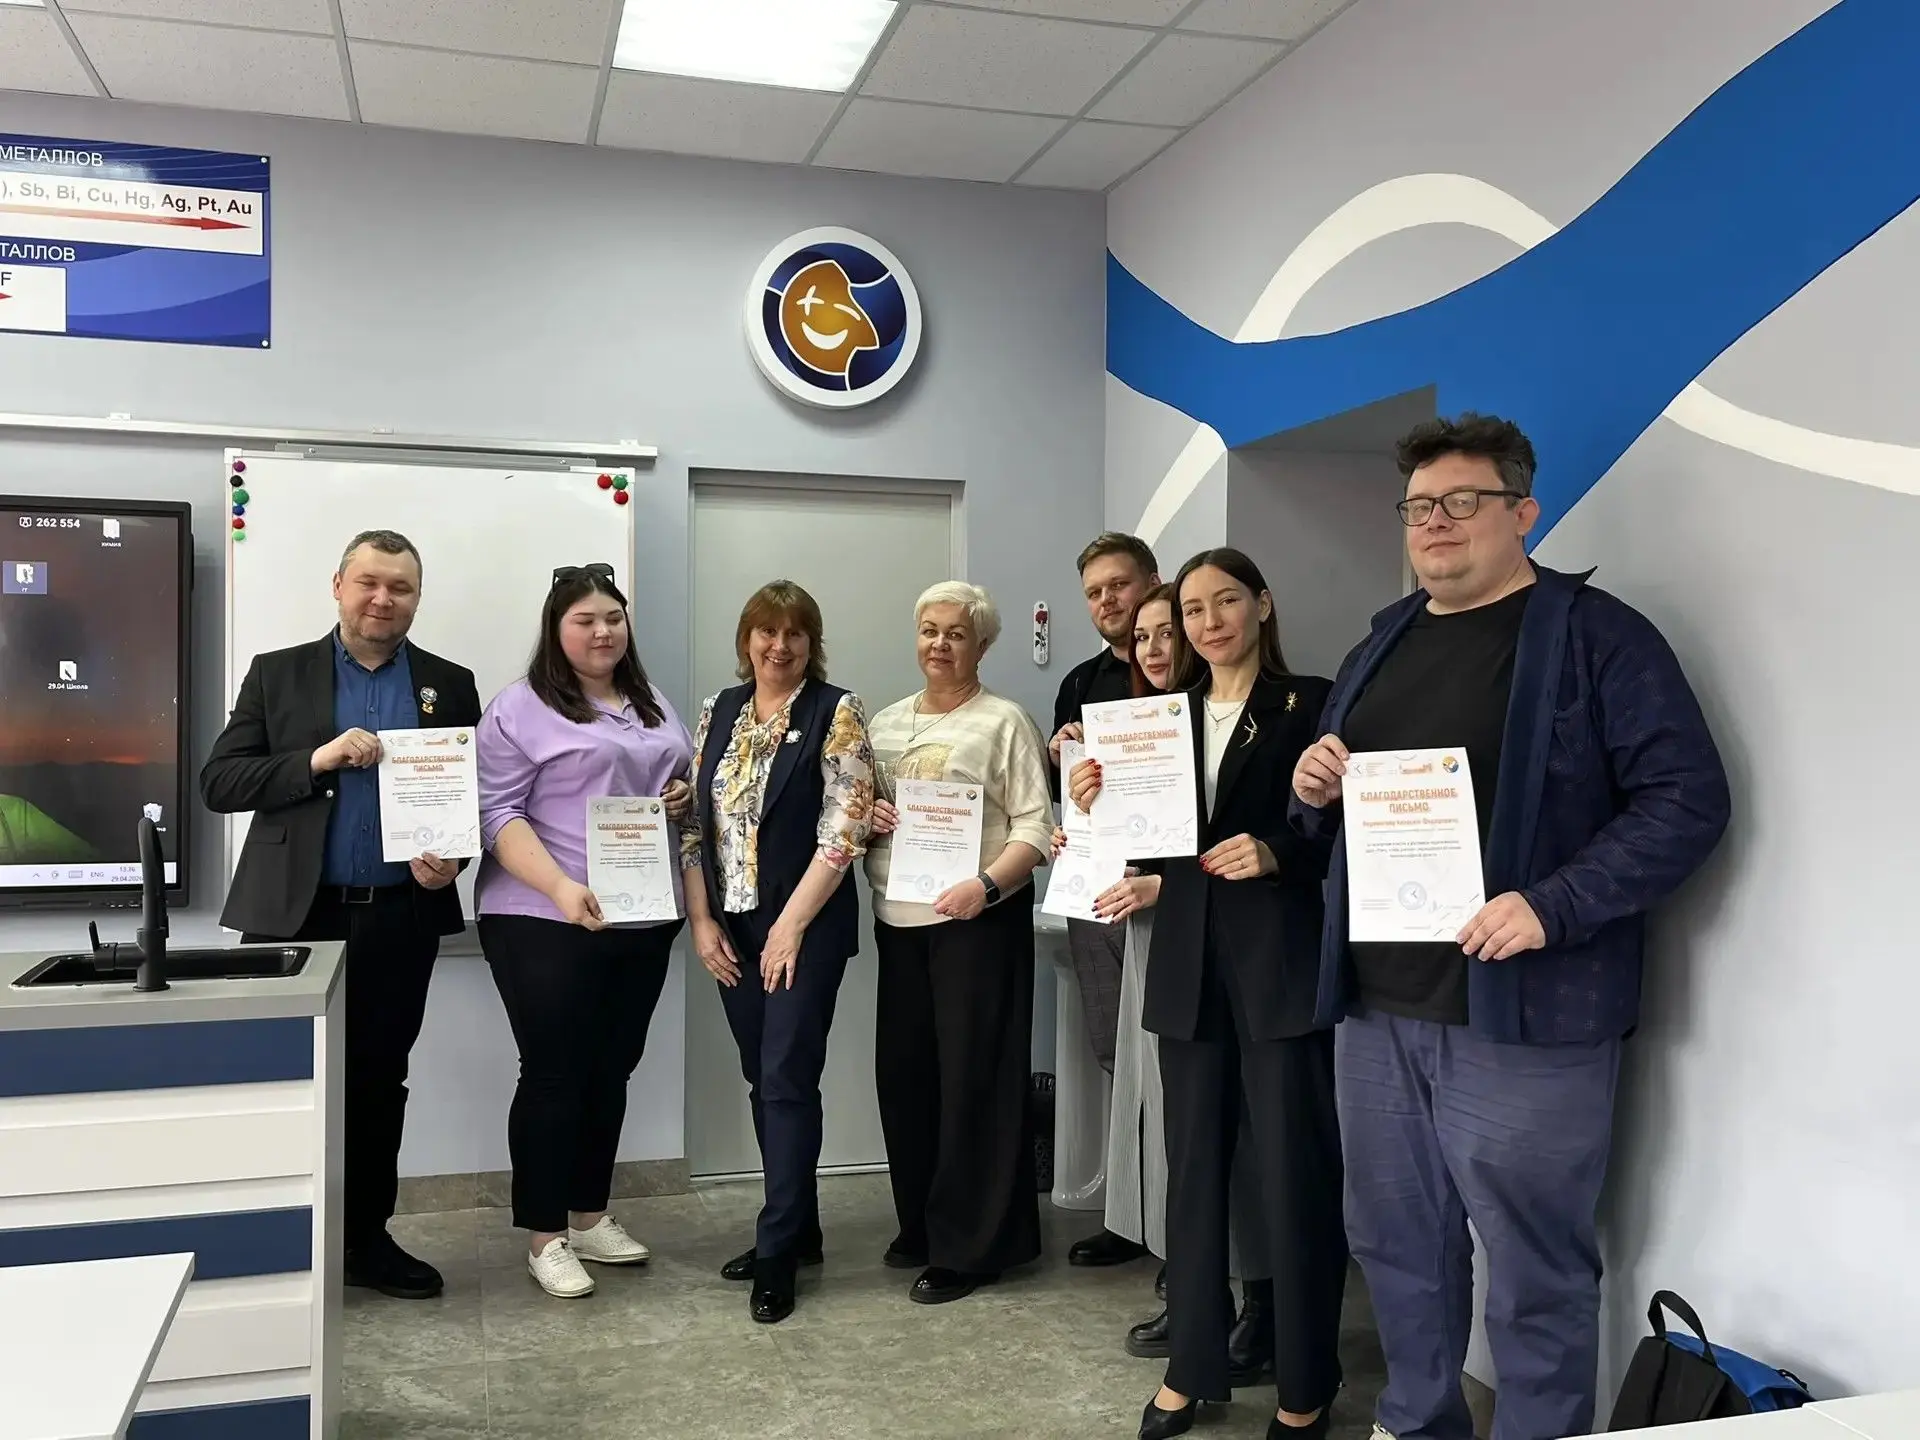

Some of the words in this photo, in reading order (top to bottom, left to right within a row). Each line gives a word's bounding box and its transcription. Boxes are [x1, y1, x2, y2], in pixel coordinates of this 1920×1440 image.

[20, 182, 49, 200] Sb,
[57, 185, 80, 202] Bi,
[87, 188, 118, 206] Cu,
[125, 190, 155, 209] Hg,
[161, 193, 191, 212] Ag,
[198, 196, 221, 214] Pt,
[226, 199, 252, 214] Au
[1, 271, 12, 286] F
[36, 517, 57, 528] 262
[59, 518, 80, 528] 554
[47, 682, 65, 690] 29.04
[1097, 728, 1179, 744] БЛАГОДАРСТВЕННОЕ
[1121, 742, 1156, 754] ПИСЬМО
[392, 754, 466, 764] БЛАГОДАРСТВЕННОЕ
[413, 764, 444, 773] ПИСЬМО
[1360, 788, 1458, 802] БЛАГОДАРСТВЕННОЕ
[906, 803, 972, 816] БЛАГОДАРСТВЕННОЕ
[1389, 801, 1431, 814] ПИСЬМО
[925, 813, 952, 824] ПИСЬМО
